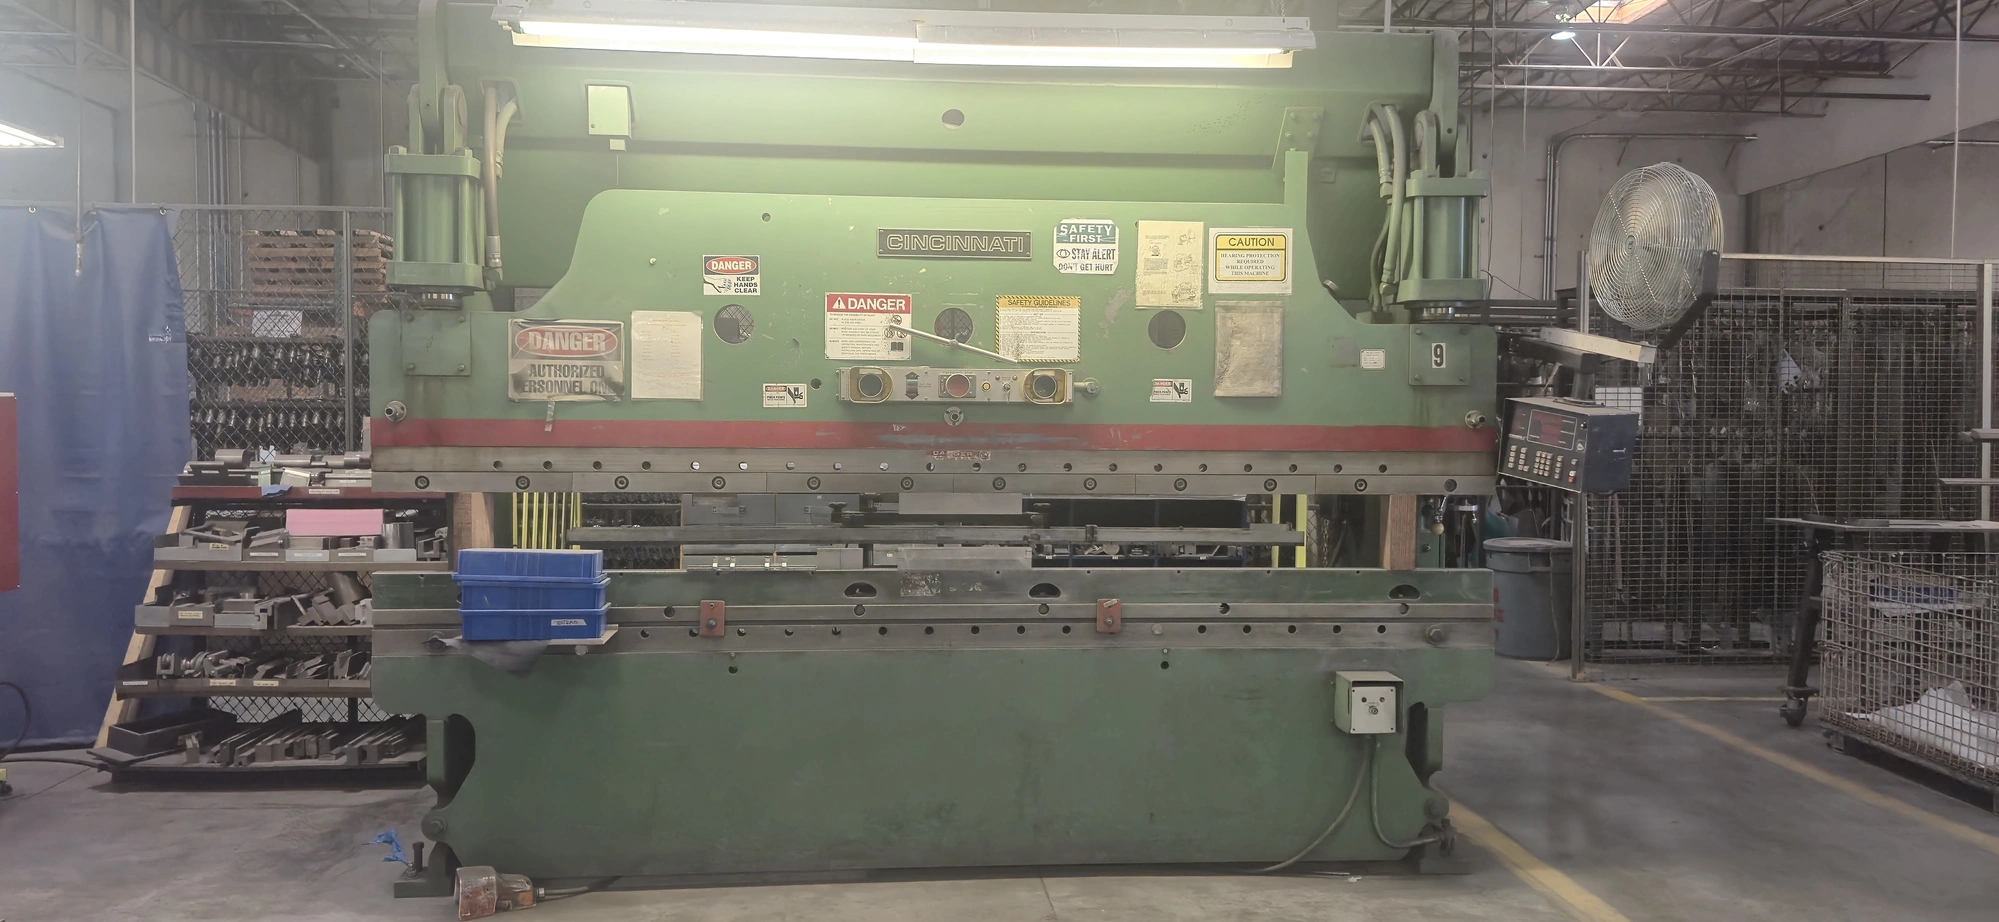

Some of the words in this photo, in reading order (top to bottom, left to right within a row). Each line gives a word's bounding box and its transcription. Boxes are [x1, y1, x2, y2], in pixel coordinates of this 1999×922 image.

[1060, 224, 1112, 236] SAFETY
[887, 234, 1024, 253] CINCINNATI
[1069, 234, 1103, 243] FIRST
[1228, 237, 1275, 247] CAUTION
[1071, 248, 1091, 260] STAY
[1091, 248, 1116, 260] ALERT
[711, 261, 752, 270] DANGER
[1079, 263, 1093, 271] GET
[1094, 263, 1113, 271] HURT
[847, 297, 906, 311] DANGER
[1033, 299, 1071, 307] GUIDELINES
[528, 331, 606, 351] DANGER
[1433, 343, 1444, 367] 9
[529, 364, 605, 379] AUTHORIZED
[523, 379, 583, 394] ERSONNEL
